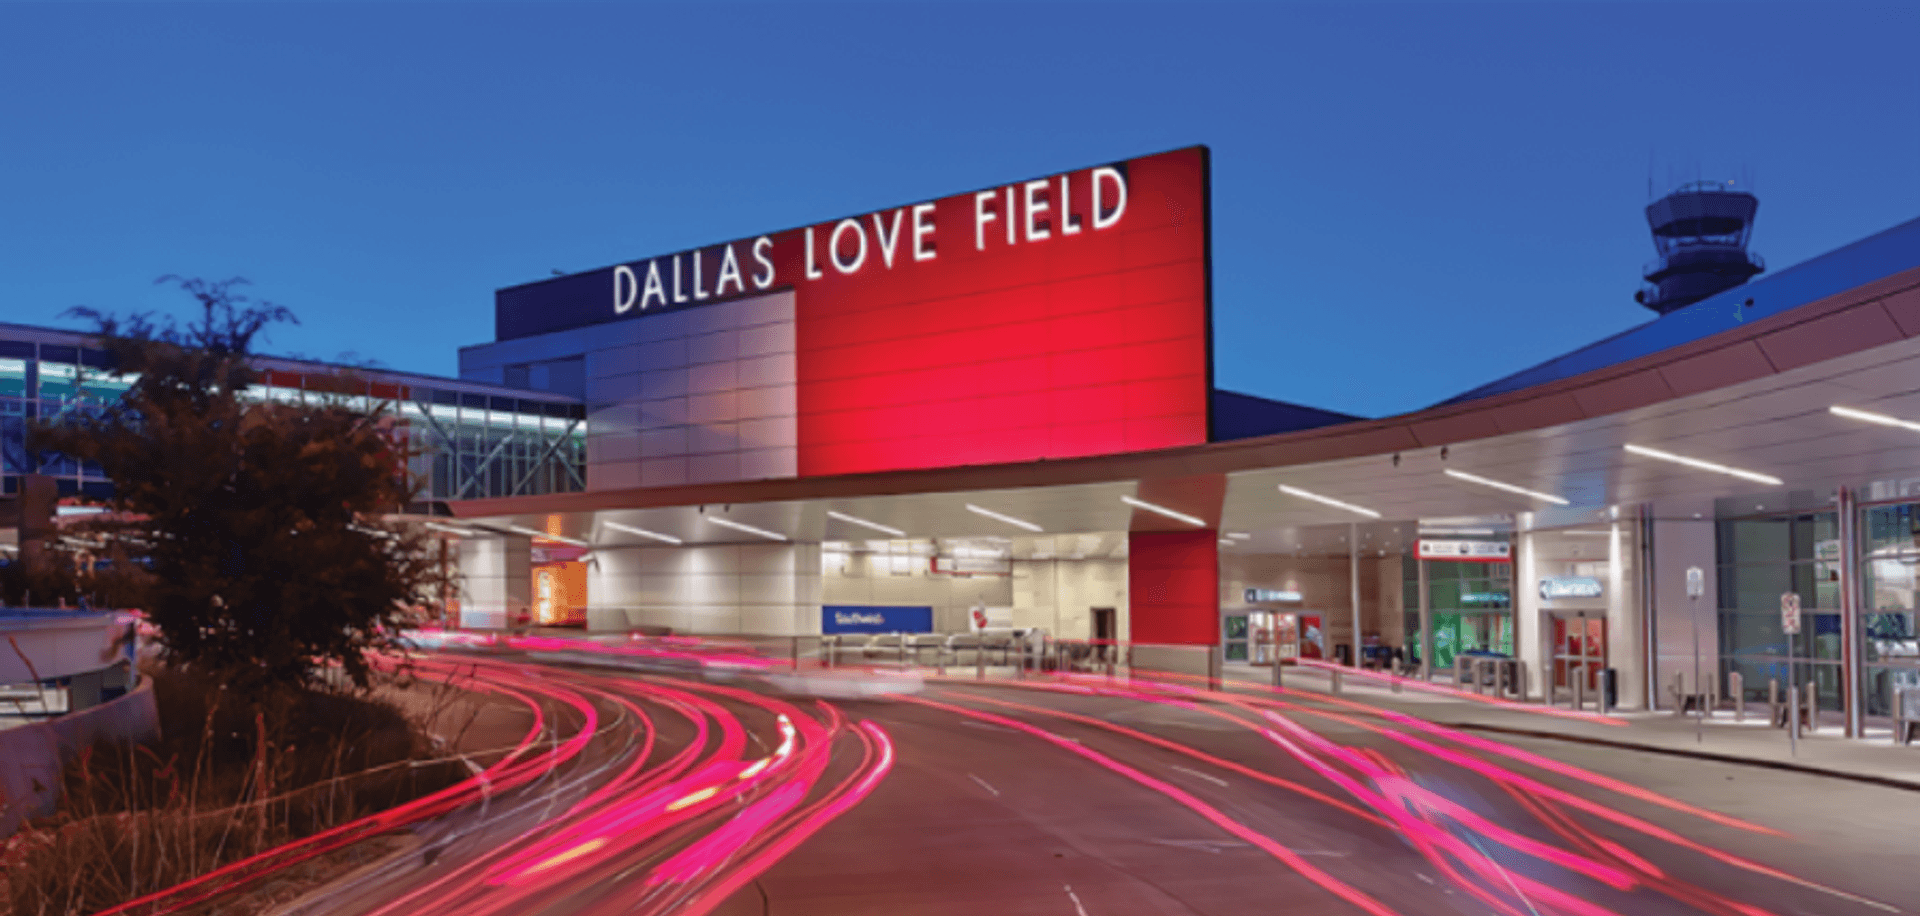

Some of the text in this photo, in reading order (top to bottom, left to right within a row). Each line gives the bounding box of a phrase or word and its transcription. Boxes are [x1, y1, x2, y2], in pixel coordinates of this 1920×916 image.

[613, 166, 1128, 314] DALLAS LOVE FIELD
